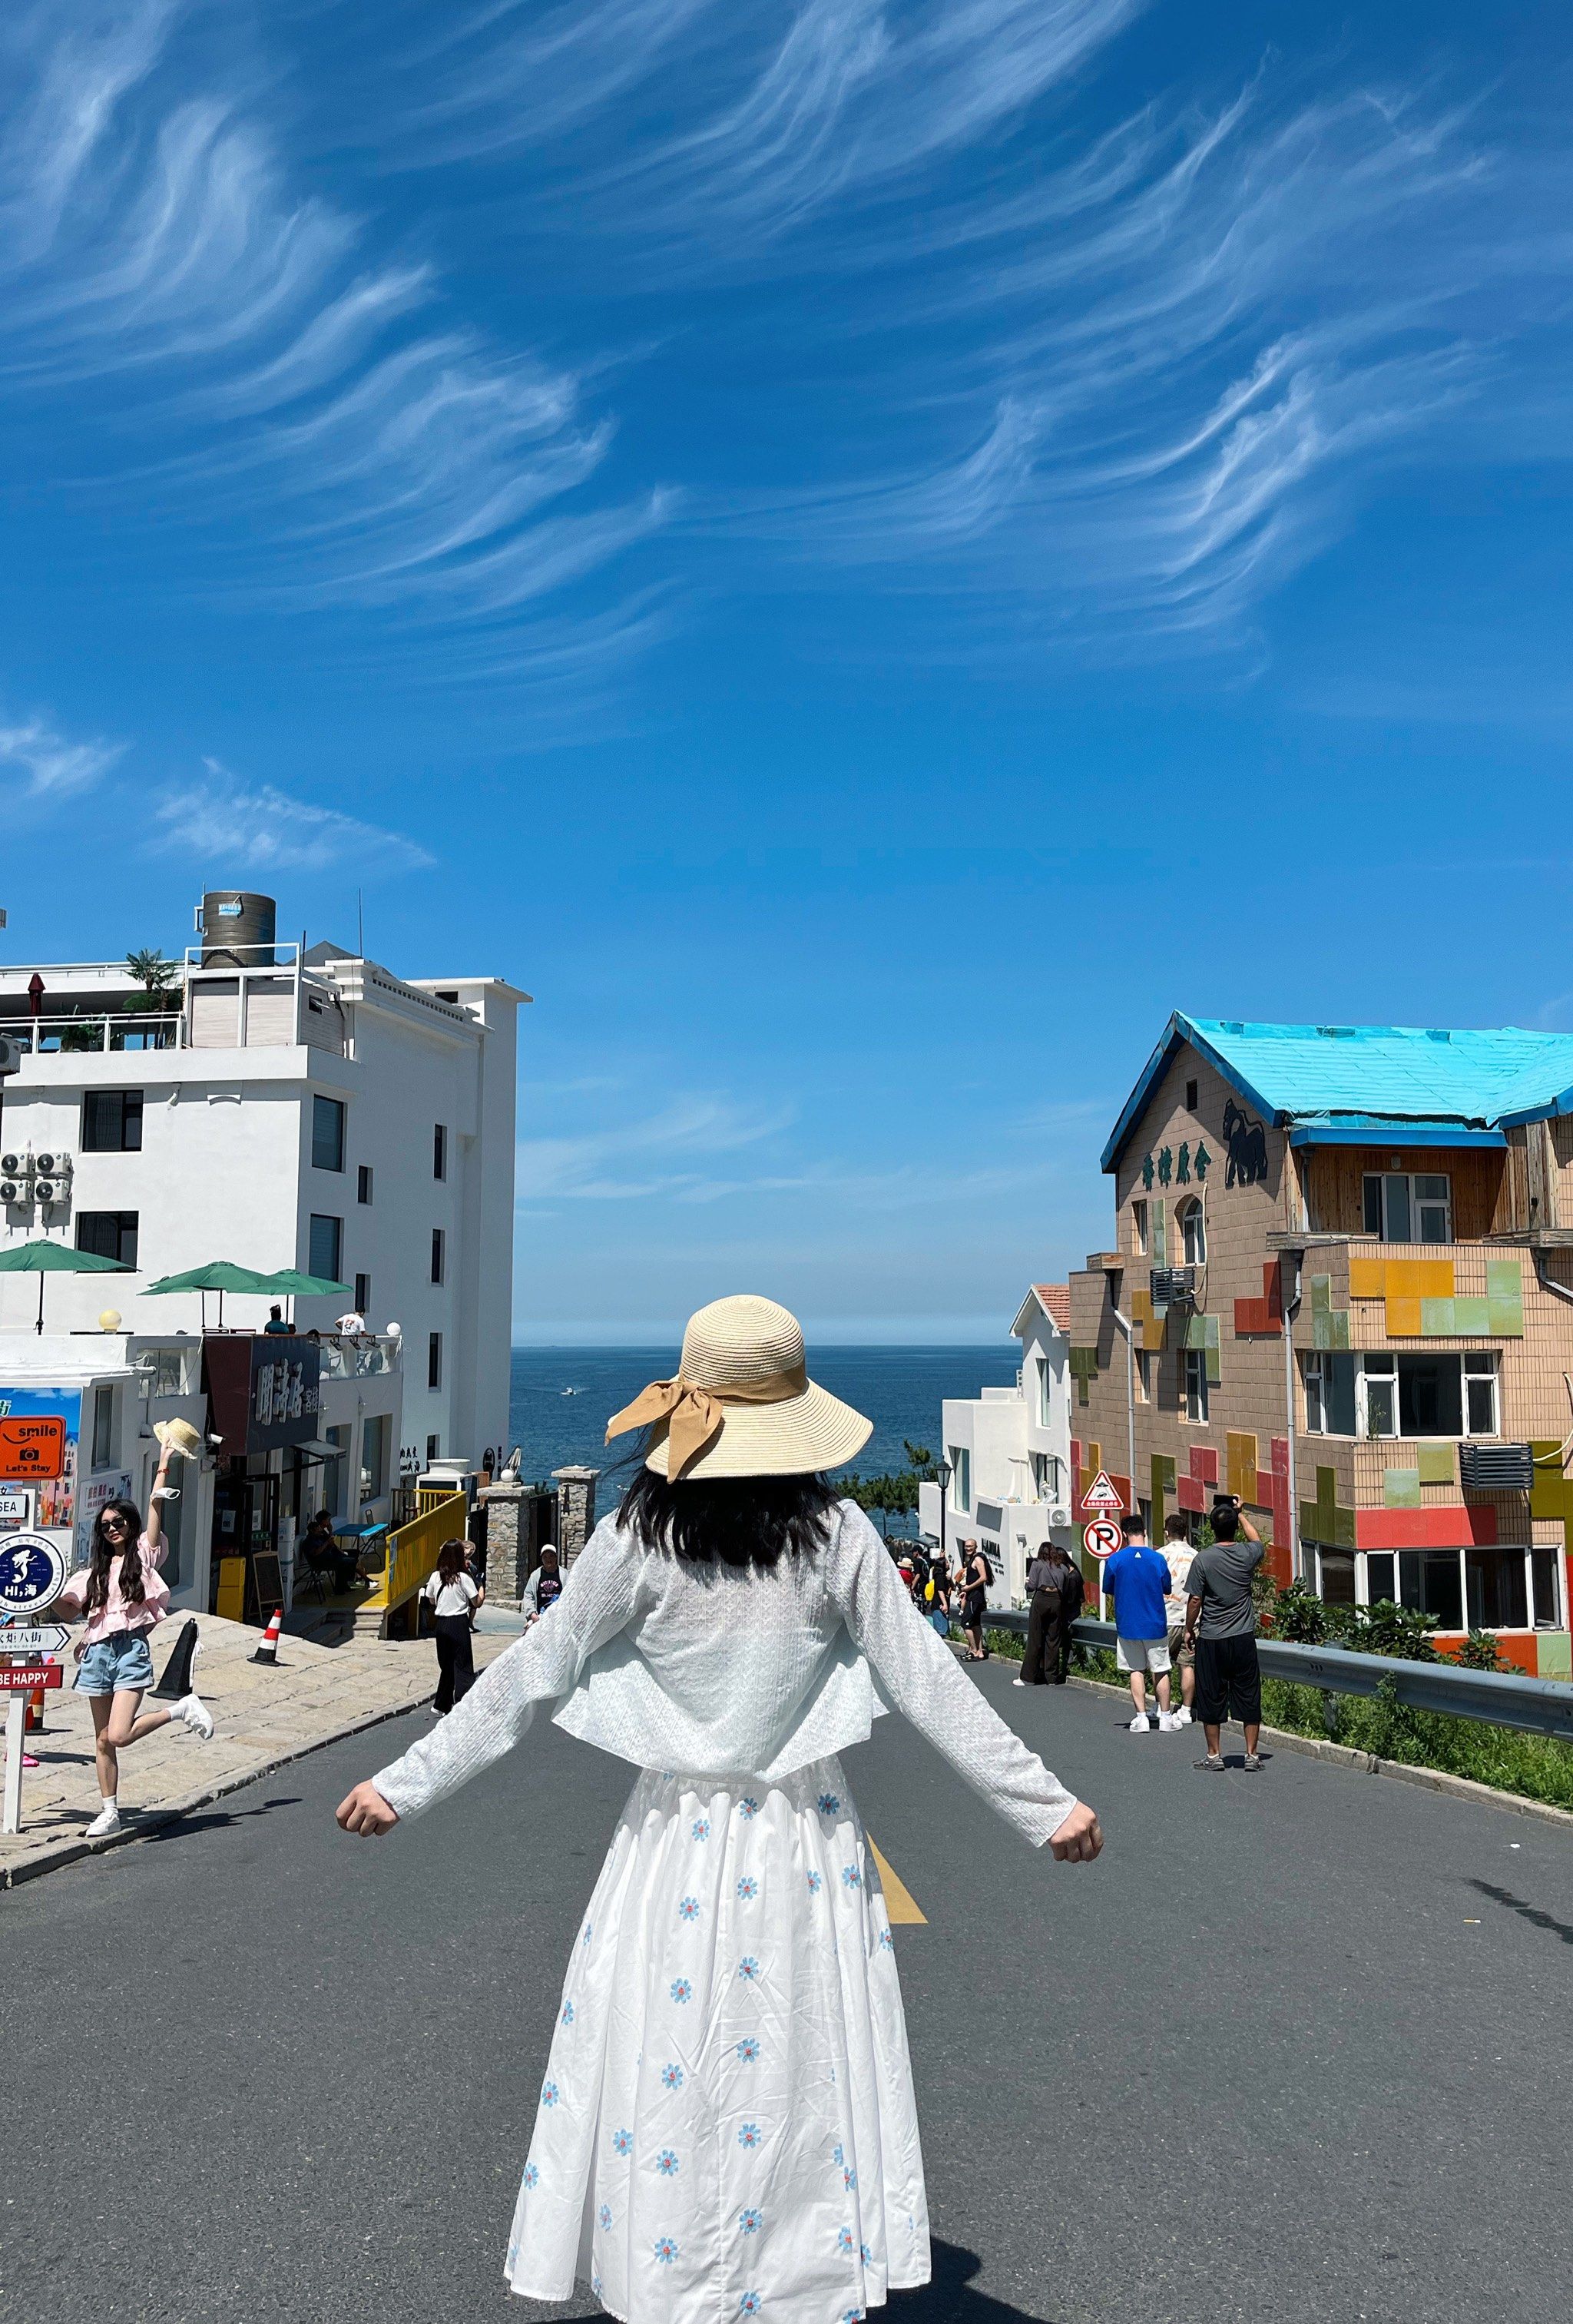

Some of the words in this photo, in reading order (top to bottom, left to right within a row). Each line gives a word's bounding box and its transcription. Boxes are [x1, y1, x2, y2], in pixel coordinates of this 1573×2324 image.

[18, 1425, 58, 1437] smile
[31, 1464, 51, 1473] Stay
[0, 1501, 17, 1512] SEA
[0, 1673, 10, 1685] BE
[12, 1672, 49, 1685] HAPPY
